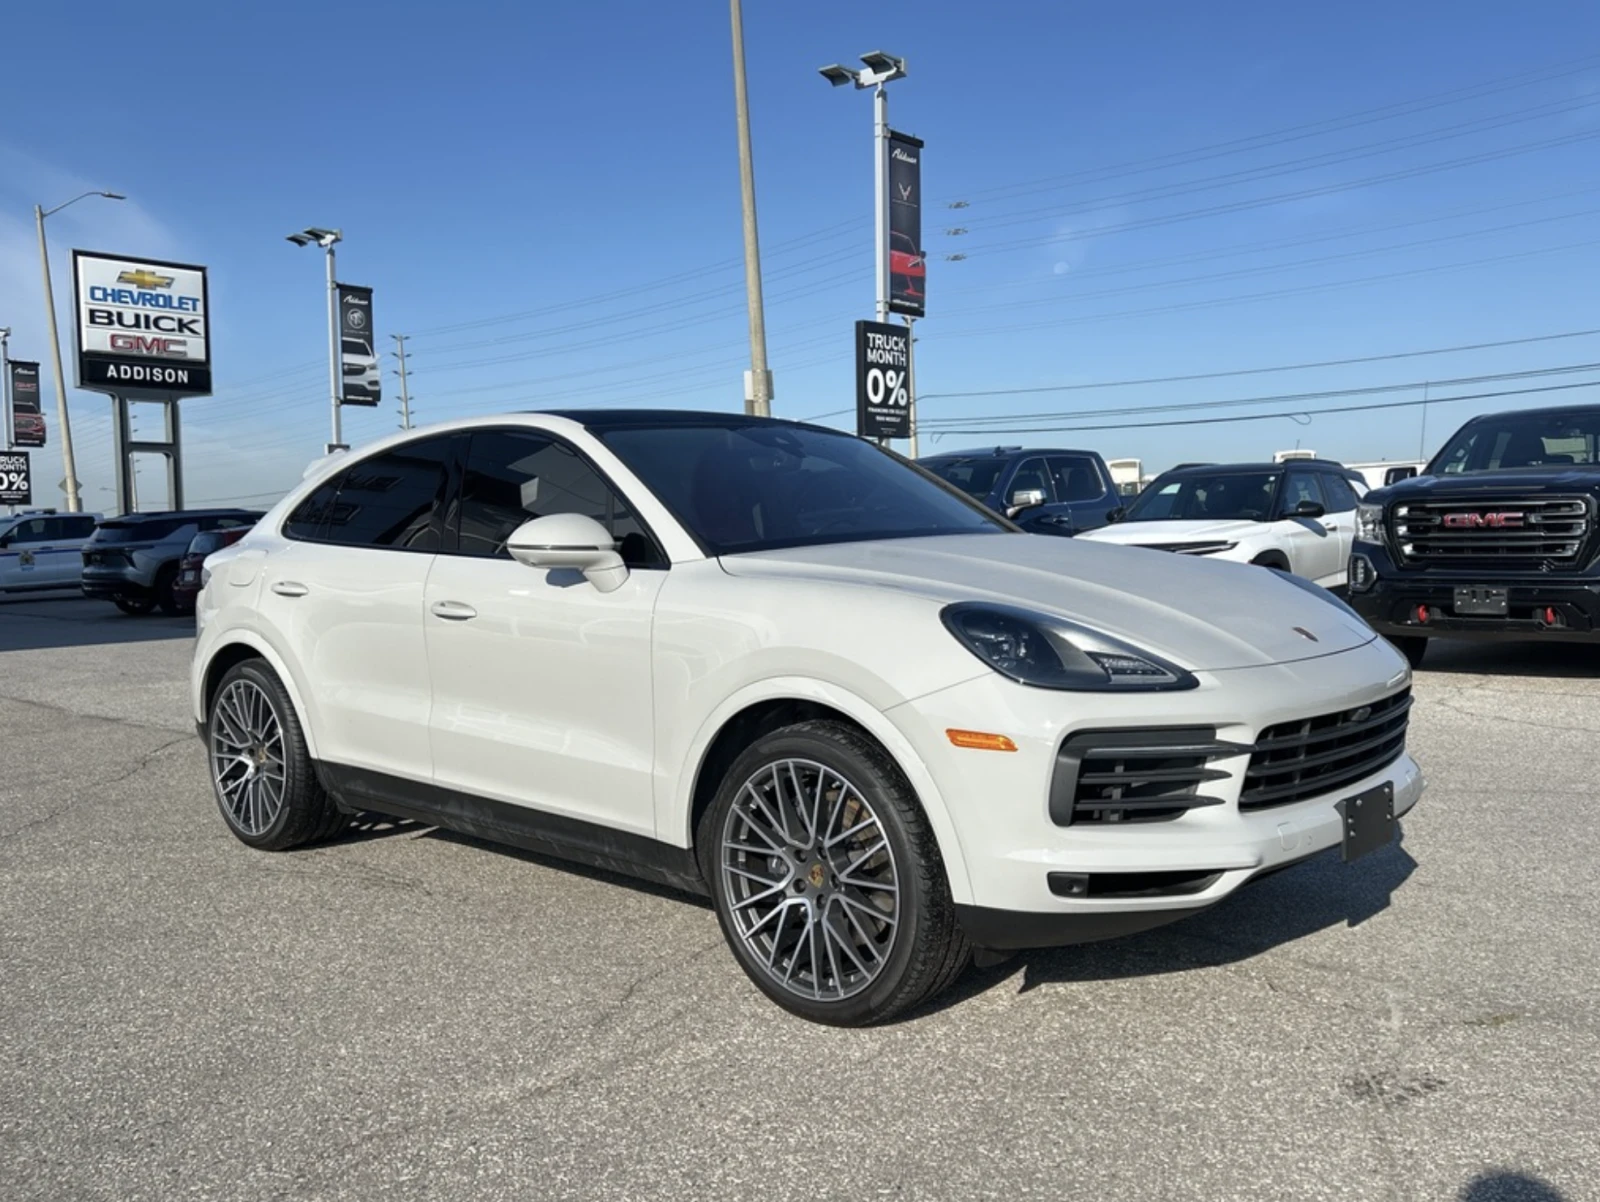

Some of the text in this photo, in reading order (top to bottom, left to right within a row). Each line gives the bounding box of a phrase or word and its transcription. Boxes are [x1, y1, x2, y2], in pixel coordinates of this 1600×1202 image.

[90, 286, 200, 312] CHEVROLET
[89, 308, 200, 335] BUICK
[110, 333, 188, 357] GMC
[867, 333, 906, 352] TRUCK
[867, 348, 906, 367] MONTH
[107, 364, 188, 384] ADDISON
[867, 368, 907, 406] 0%
[0, 456, 26, 464] RUCK
[1443, 512, 1524, 528] GMC
